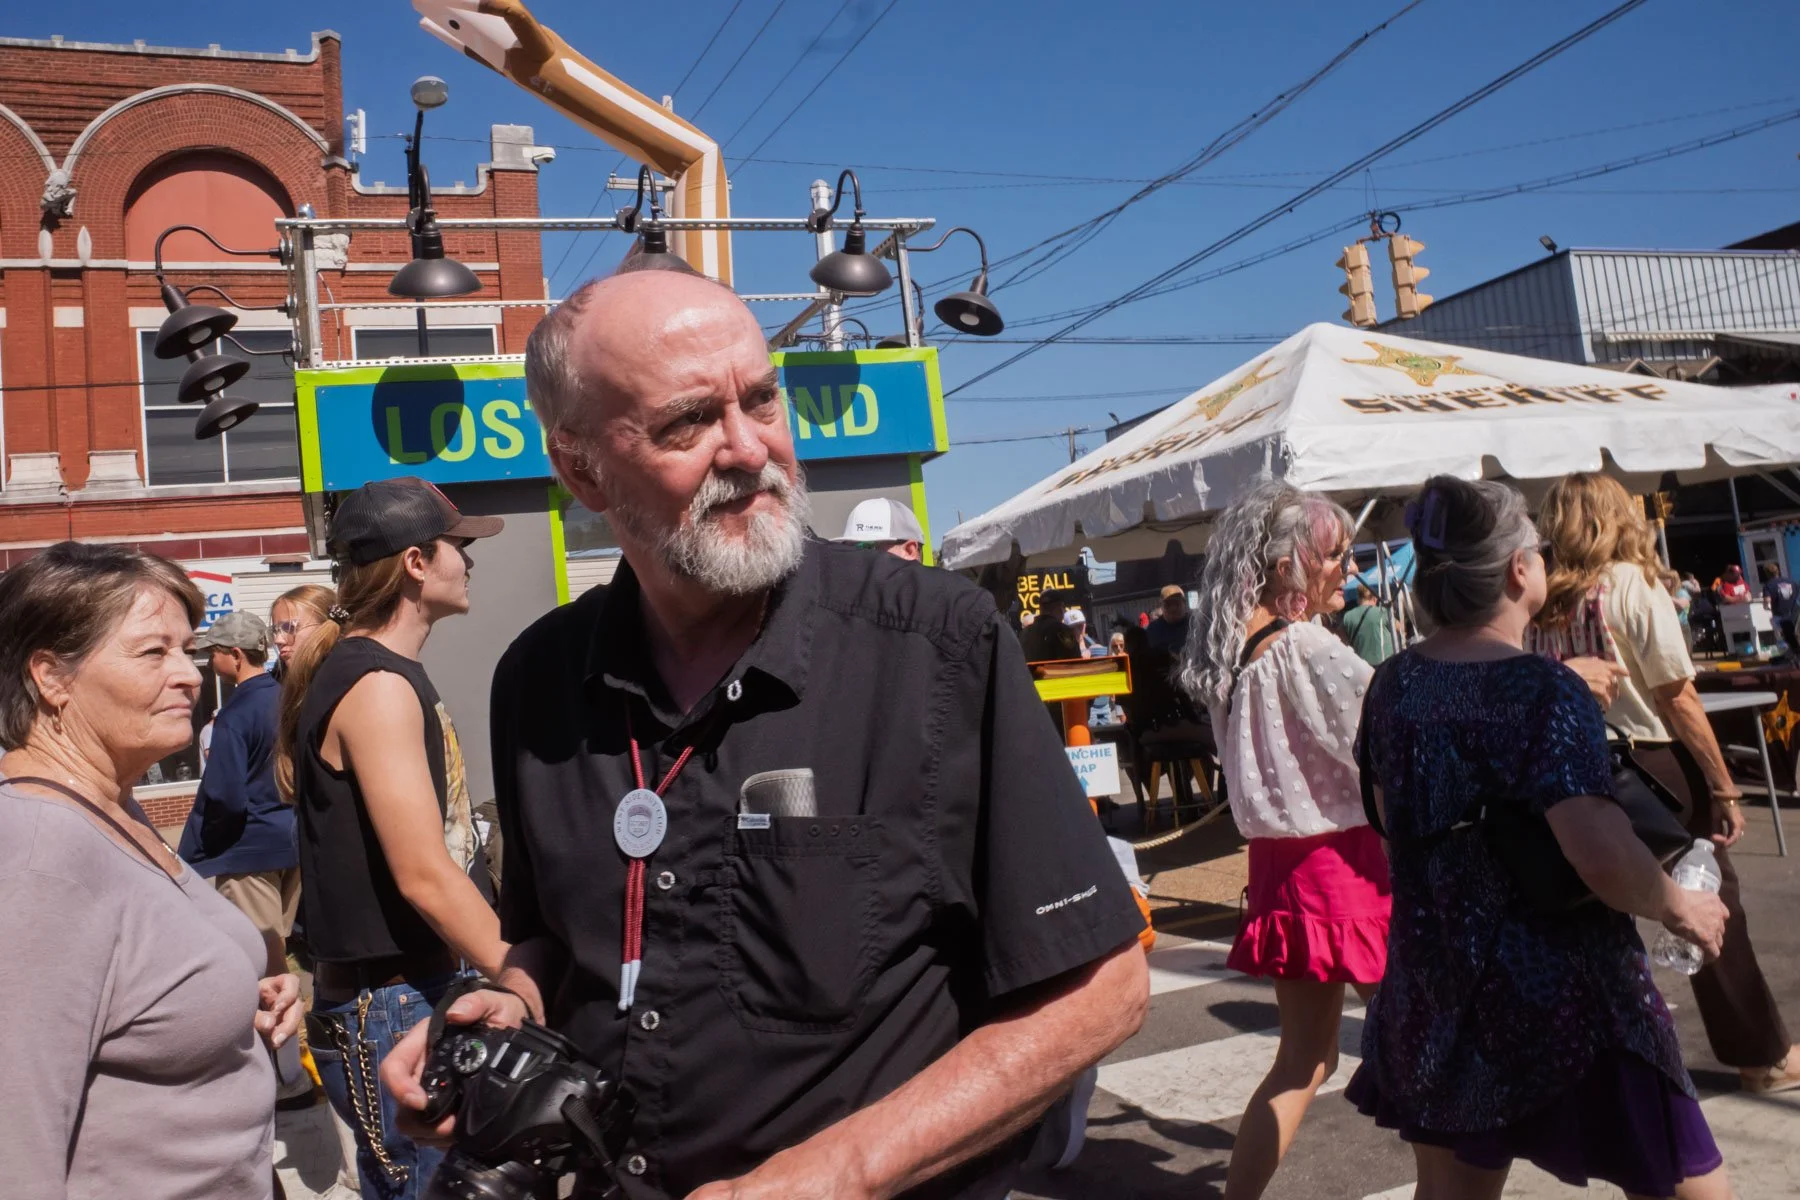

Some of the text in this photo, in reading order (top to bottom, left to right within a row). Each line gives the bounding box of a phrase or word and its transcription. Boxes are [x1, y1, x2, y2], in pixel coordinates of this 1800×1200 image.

[1341, 383, 1667, 414] SHERIFF
[1018, 573, 1075, 592] BE ALL
[1067, 748, 1112, 760] NCHIE
